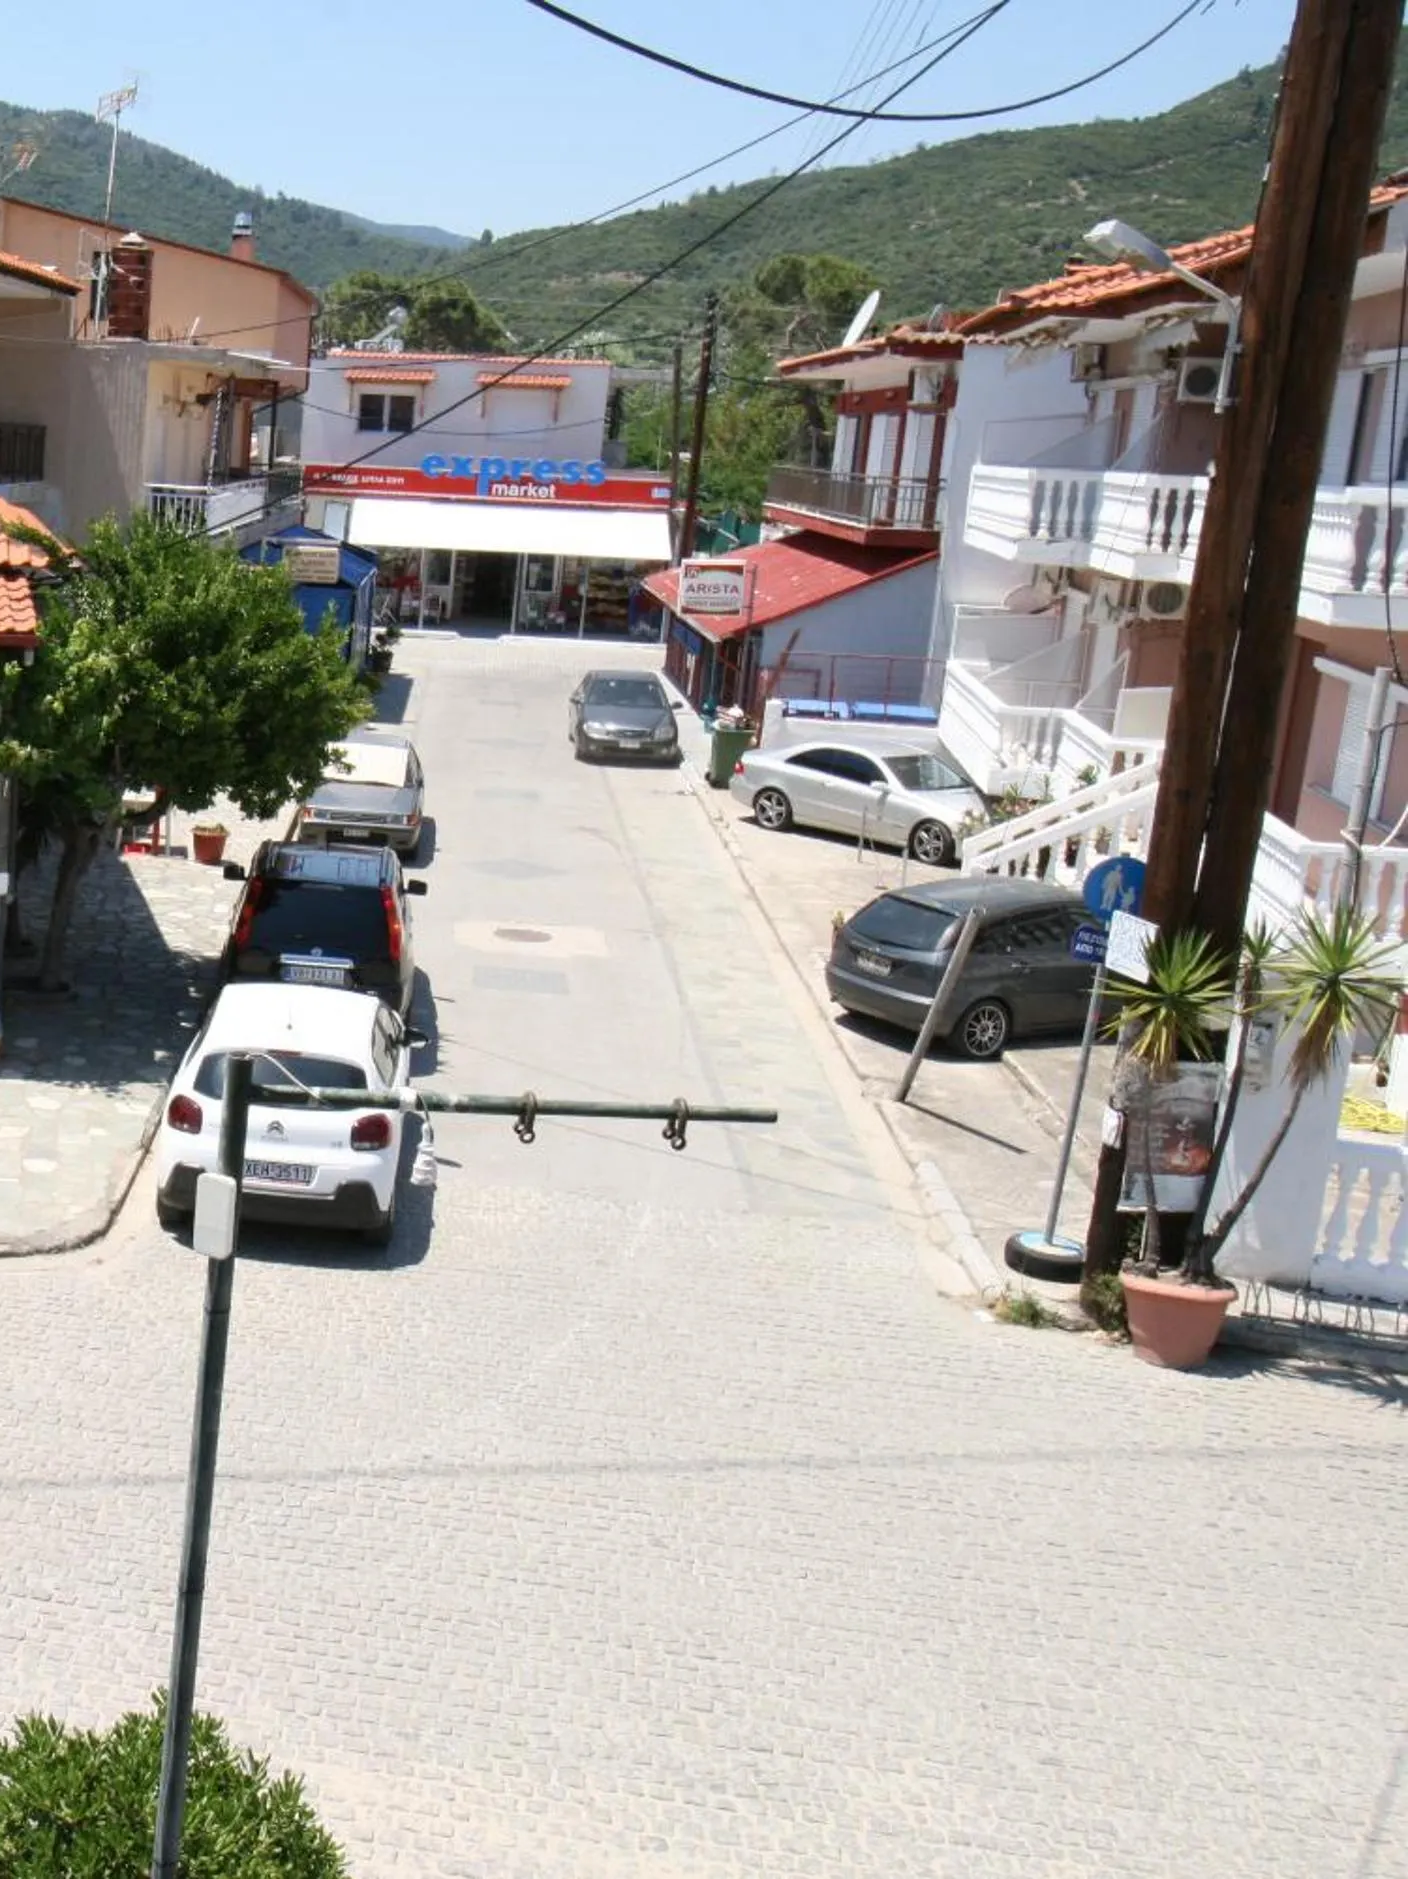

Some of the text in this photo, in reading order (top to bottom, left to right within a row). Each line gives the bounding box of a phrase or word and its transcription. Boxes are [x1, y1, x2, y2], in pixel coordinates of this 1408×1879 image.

[421, 453, 606, 496] express
[491, 482, 556, 498] market
[685, 583, 740, 595] ARISTA
